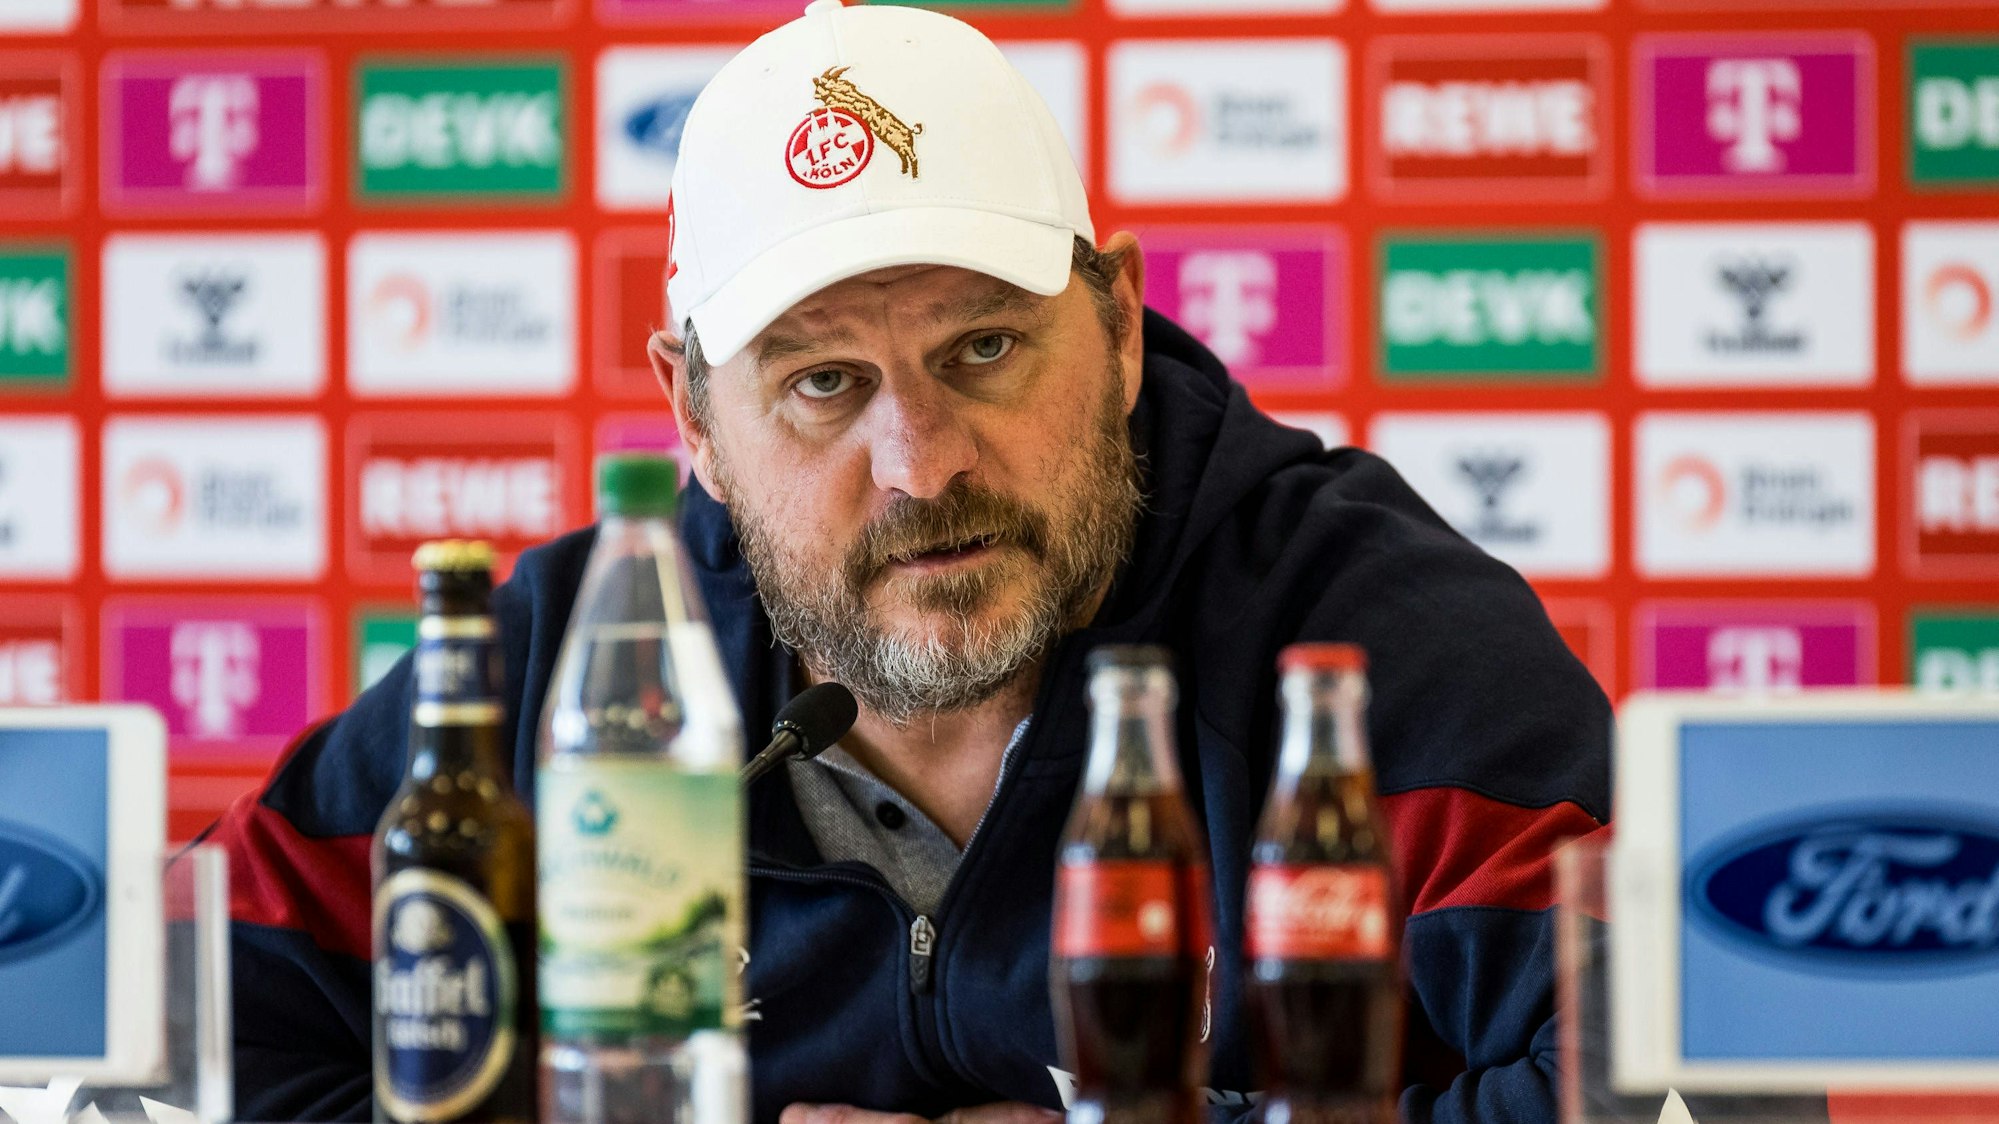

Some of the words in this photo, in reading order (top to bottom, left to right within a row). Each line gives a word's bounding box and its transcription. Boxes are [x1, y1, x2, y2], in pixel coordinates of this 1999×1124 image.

[362, 93, 562, 168] DEVK
[1381, 80, 1596, 156] REWE
[809, 157, 855, 180] KÖLN
[1383, 269, 1594, 346] DEVK
[361, 458, 562, 536] REWE
